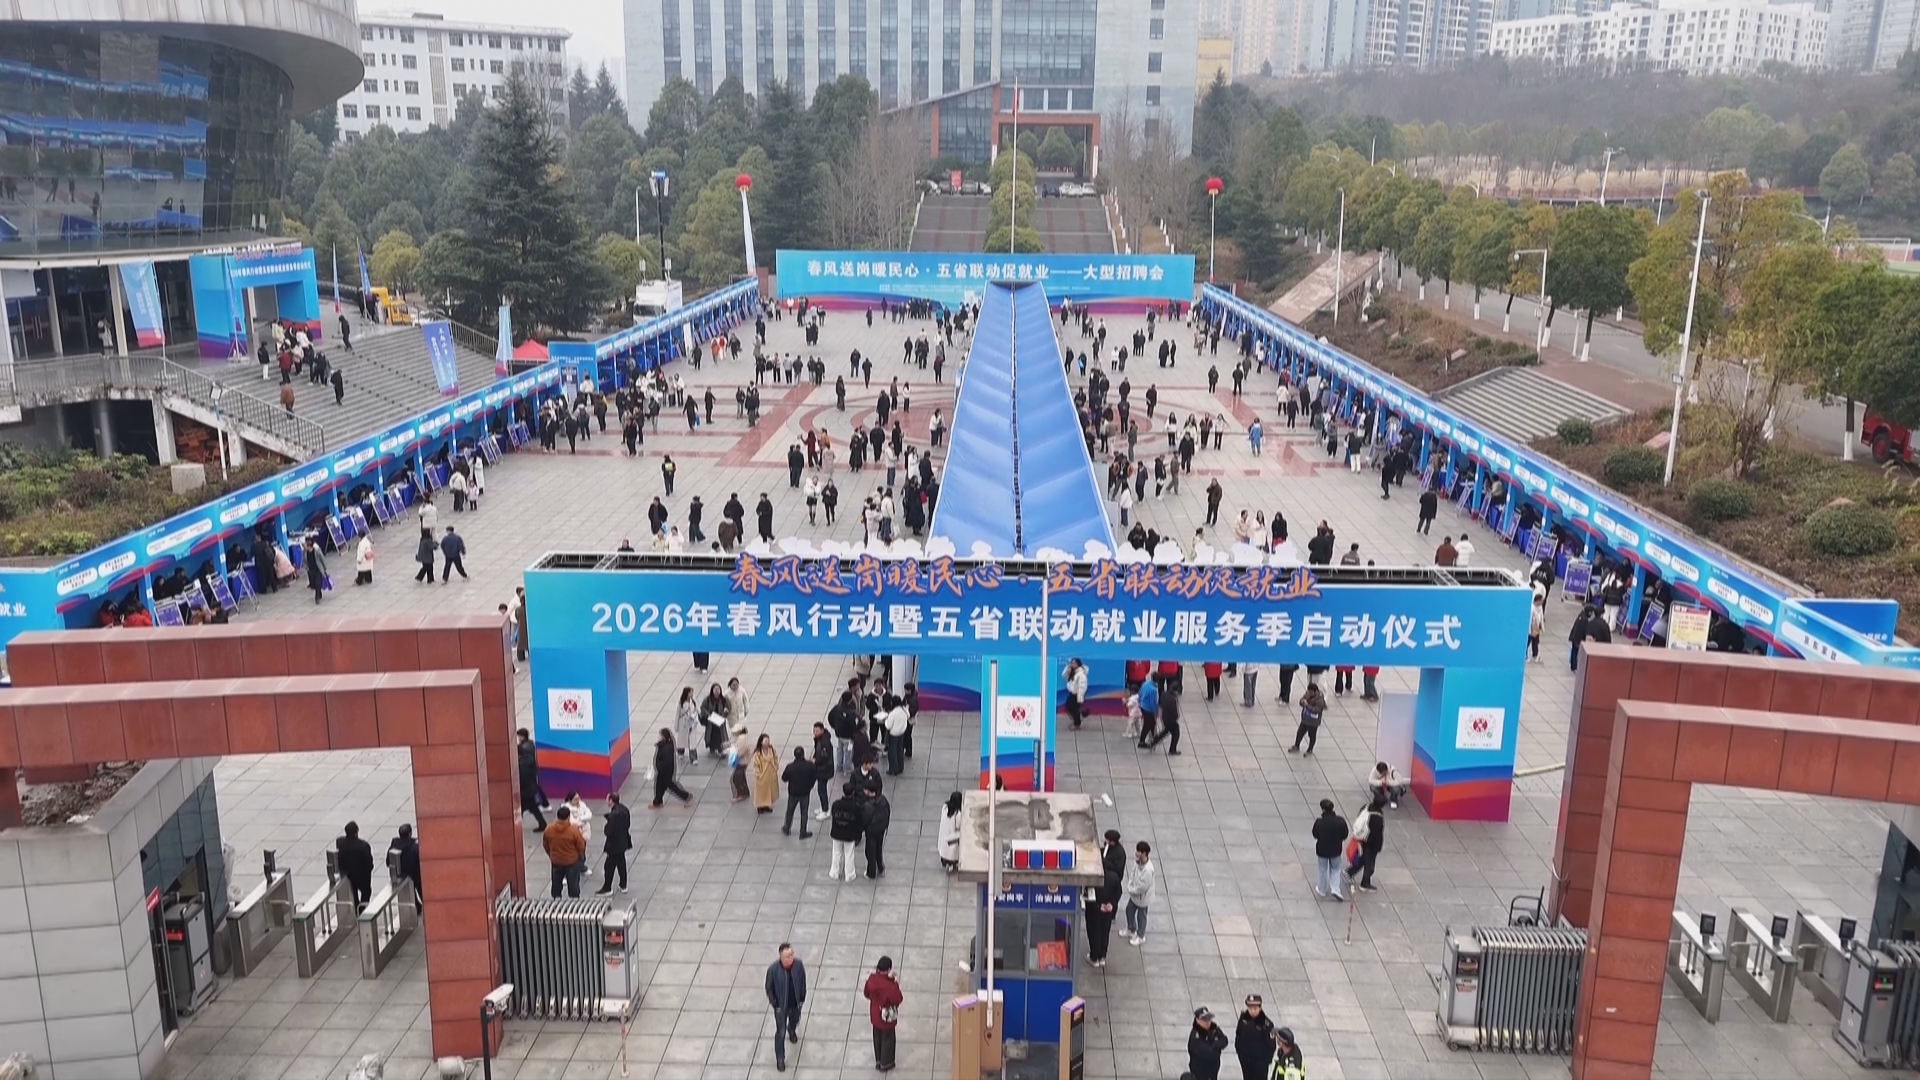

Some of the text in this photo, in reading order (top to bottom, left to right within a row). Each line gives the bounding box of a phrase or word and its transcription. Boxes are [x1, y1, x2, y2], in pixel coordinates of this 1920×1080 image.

[730, 552, 1321, 601] 春风送岗暖民心·五省联动促就业
[591, 601, 1461, 650] 2026年春风行动暨五省联动就业服务季启动仪式
